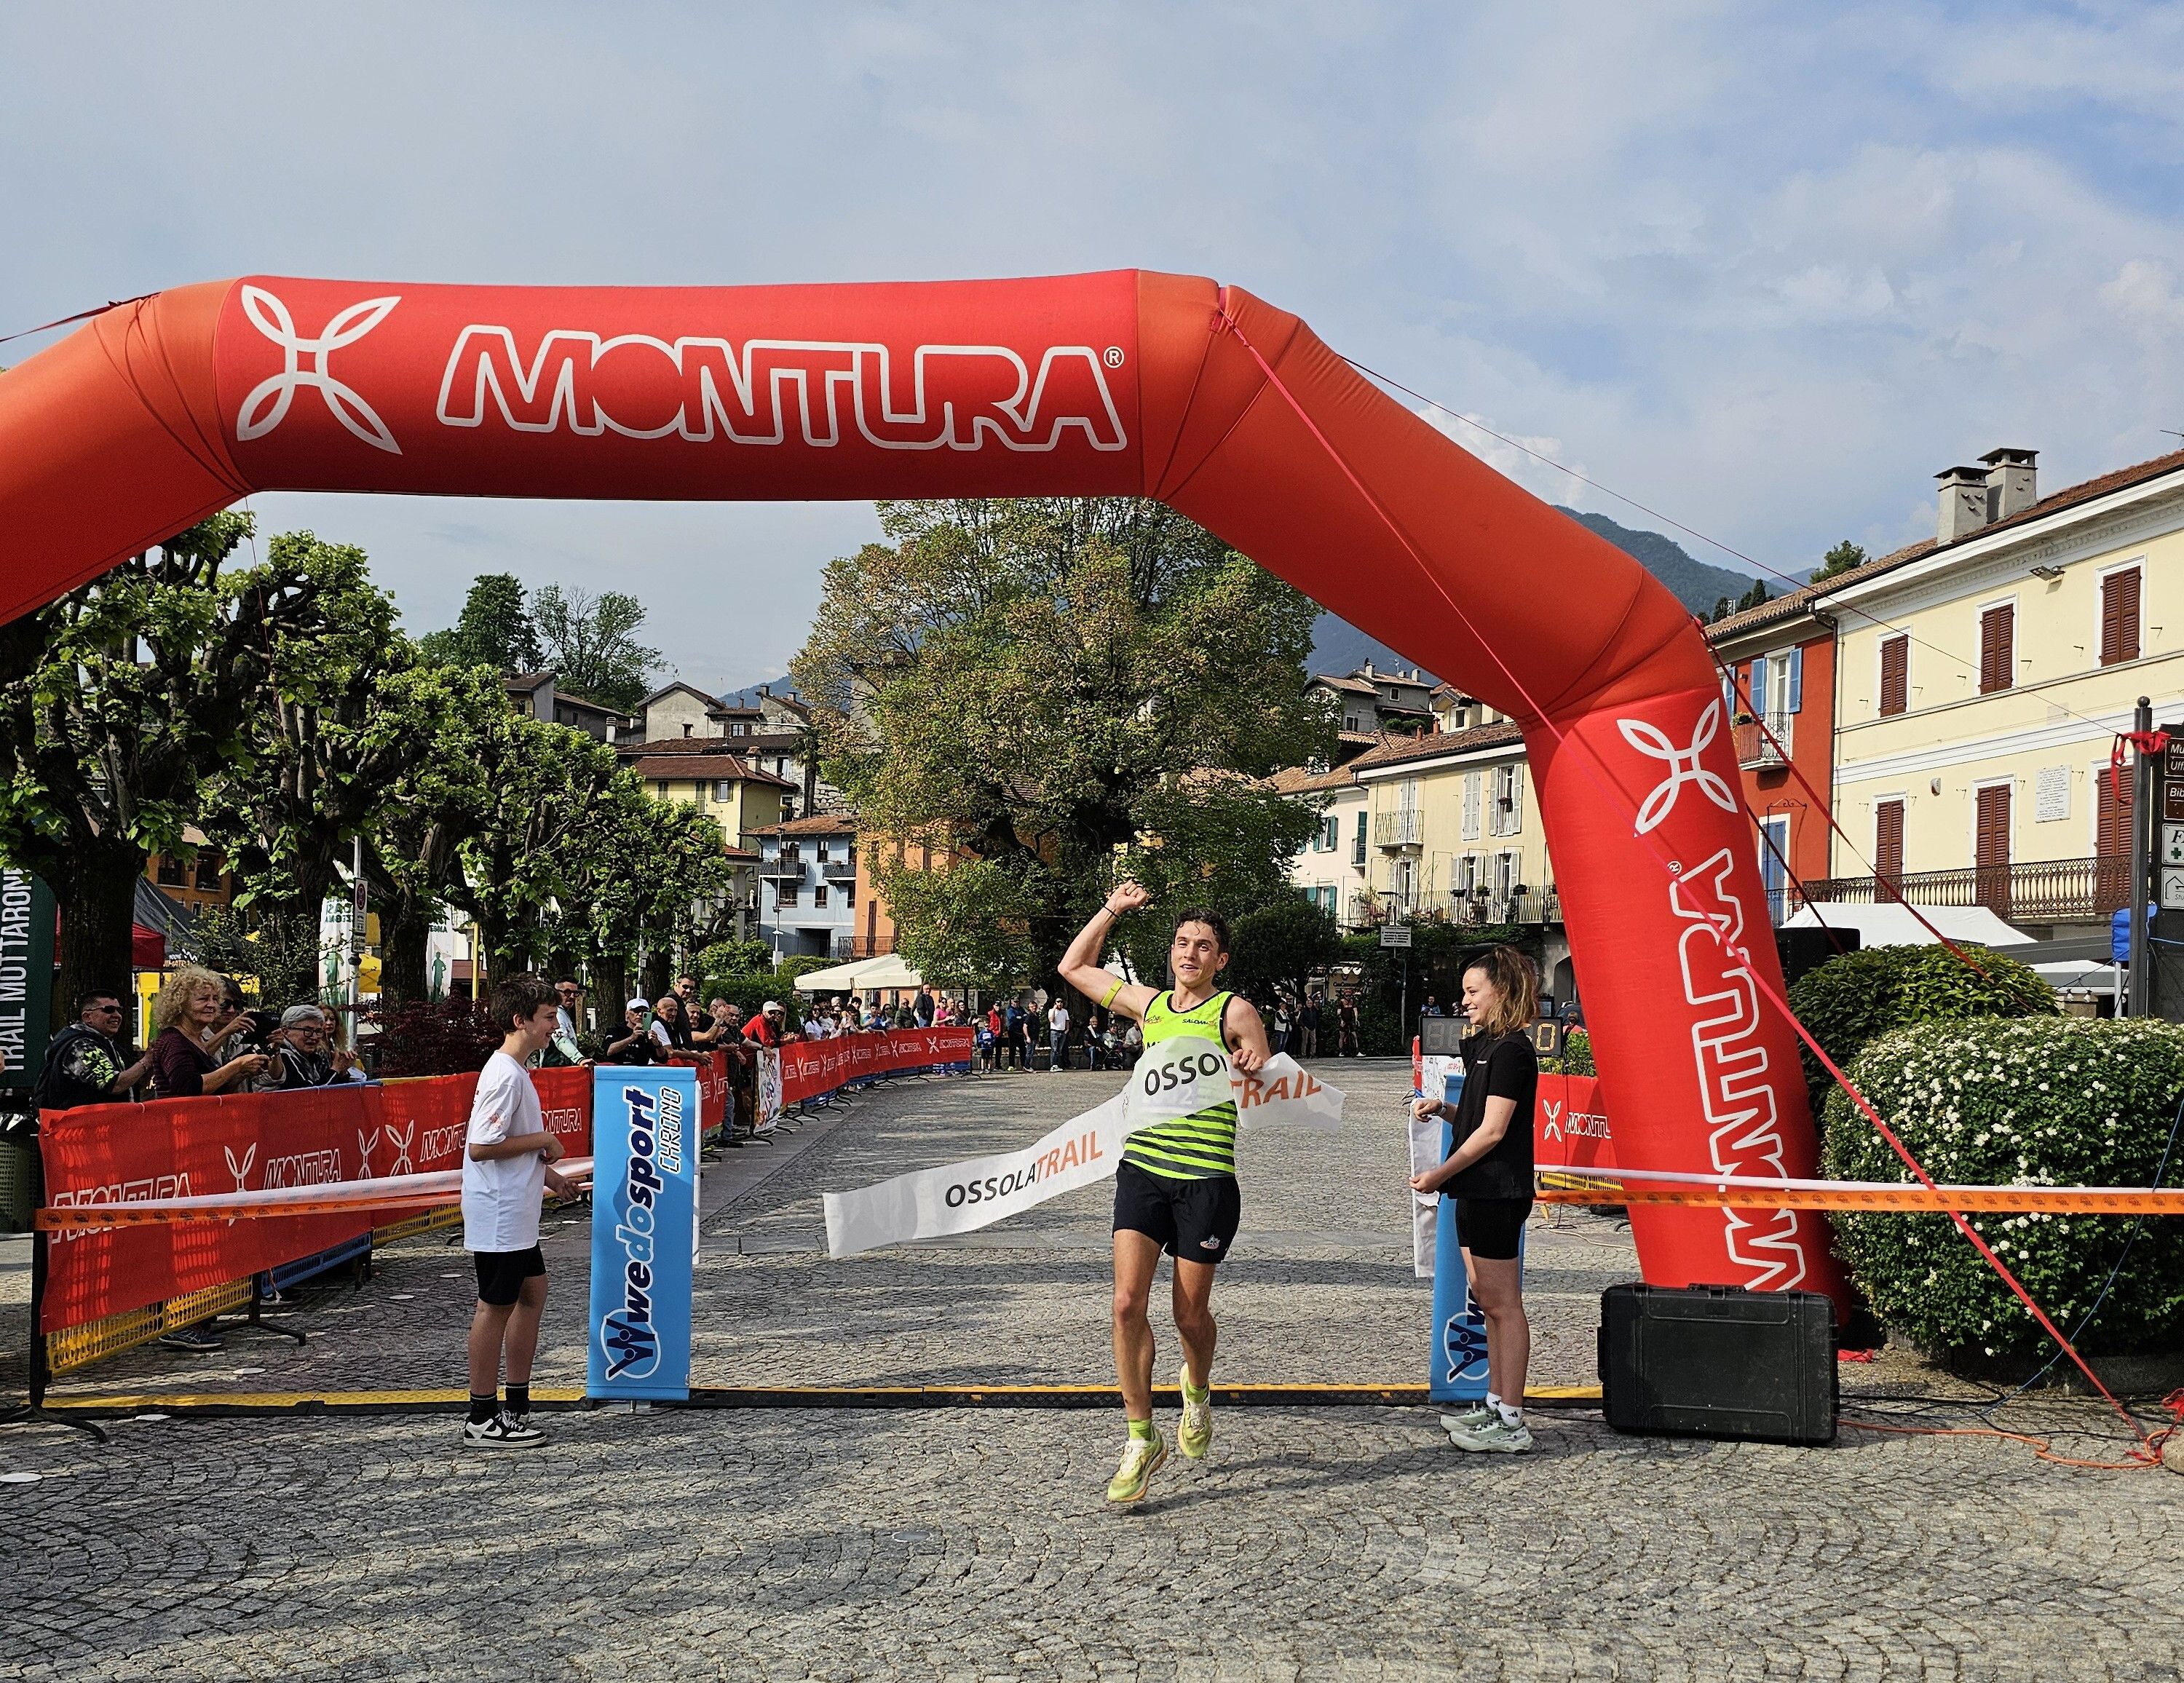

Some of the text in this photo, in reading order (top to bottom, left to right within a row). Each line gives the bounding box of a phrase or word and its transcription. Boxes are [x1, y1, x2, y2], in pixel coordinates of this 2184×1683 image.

[658, 1085, 682, 1174] CHRONO
[1564, 1112, 1612, 1139] MONTU
[616, 1085, 663, 1323] wedosport
